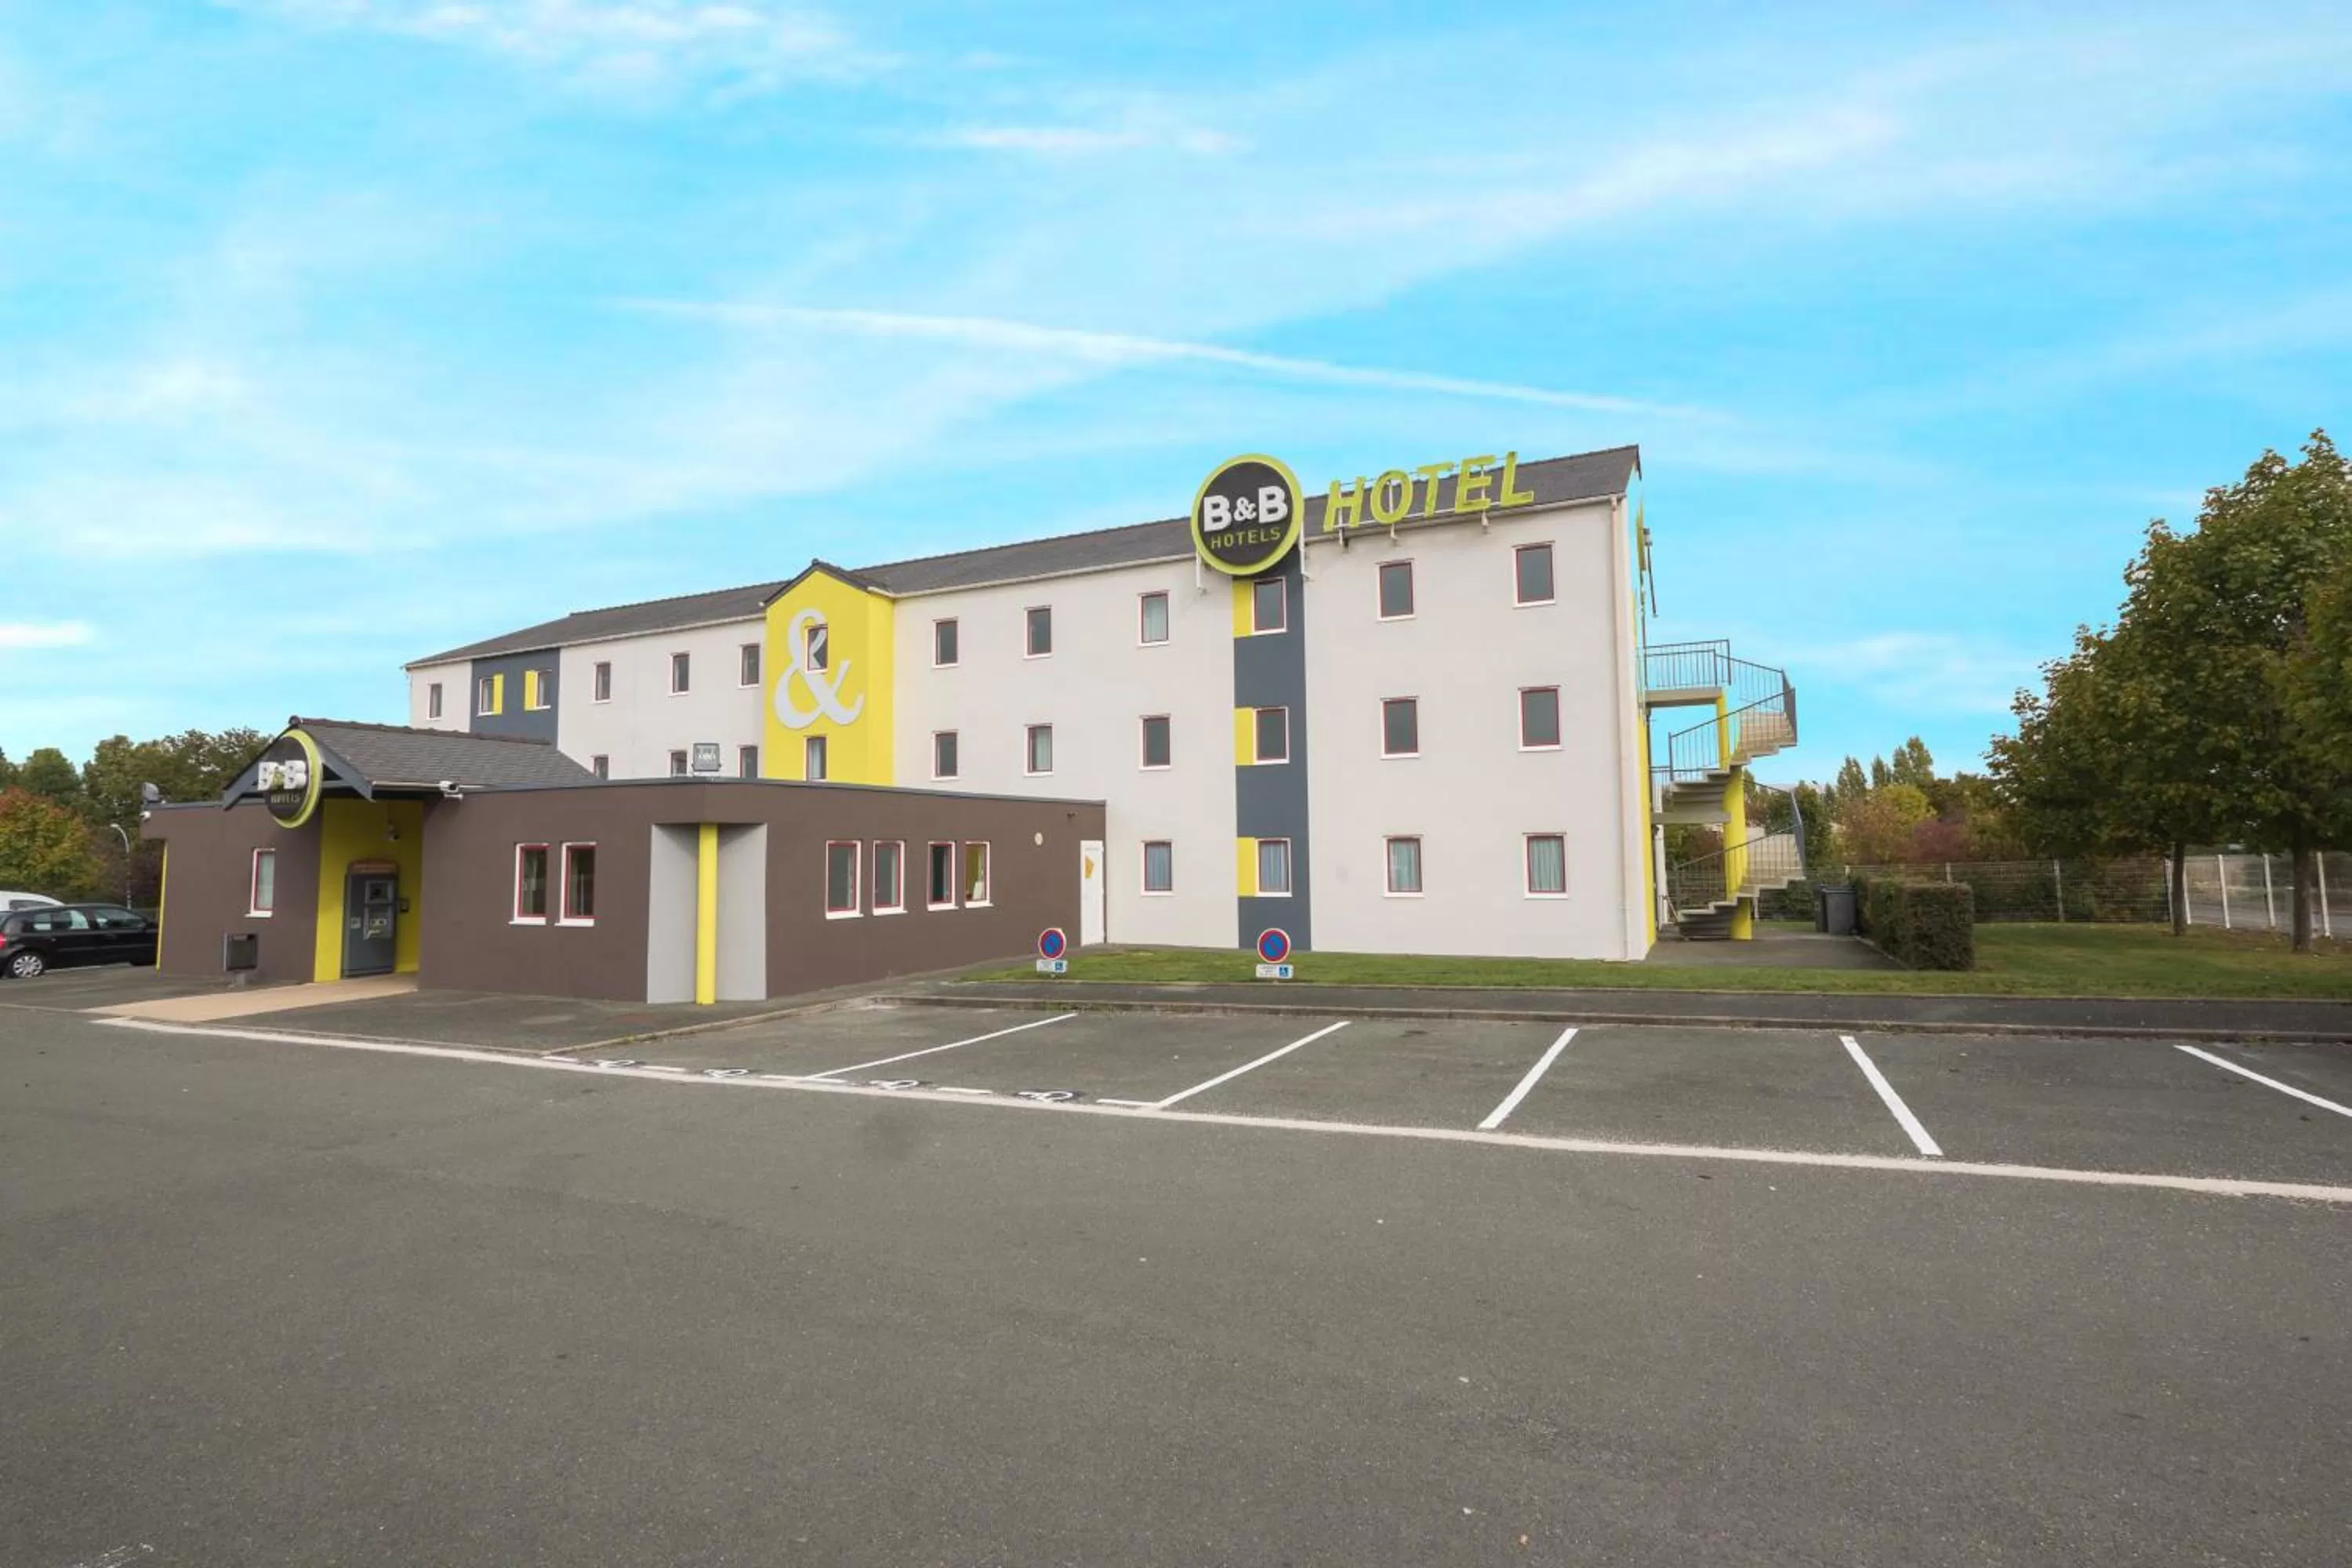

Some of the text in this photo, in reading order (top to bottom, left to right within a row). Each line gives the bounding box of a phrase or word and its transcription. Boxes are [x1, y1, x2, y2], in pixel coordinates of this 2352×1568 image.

[1203, 486, 1287, 532] B&B
[1323, 452, 1534, 532] HOTEL
[1211, 527, 1280, 549] HOTELS
[775, 608, 864, 729] &
